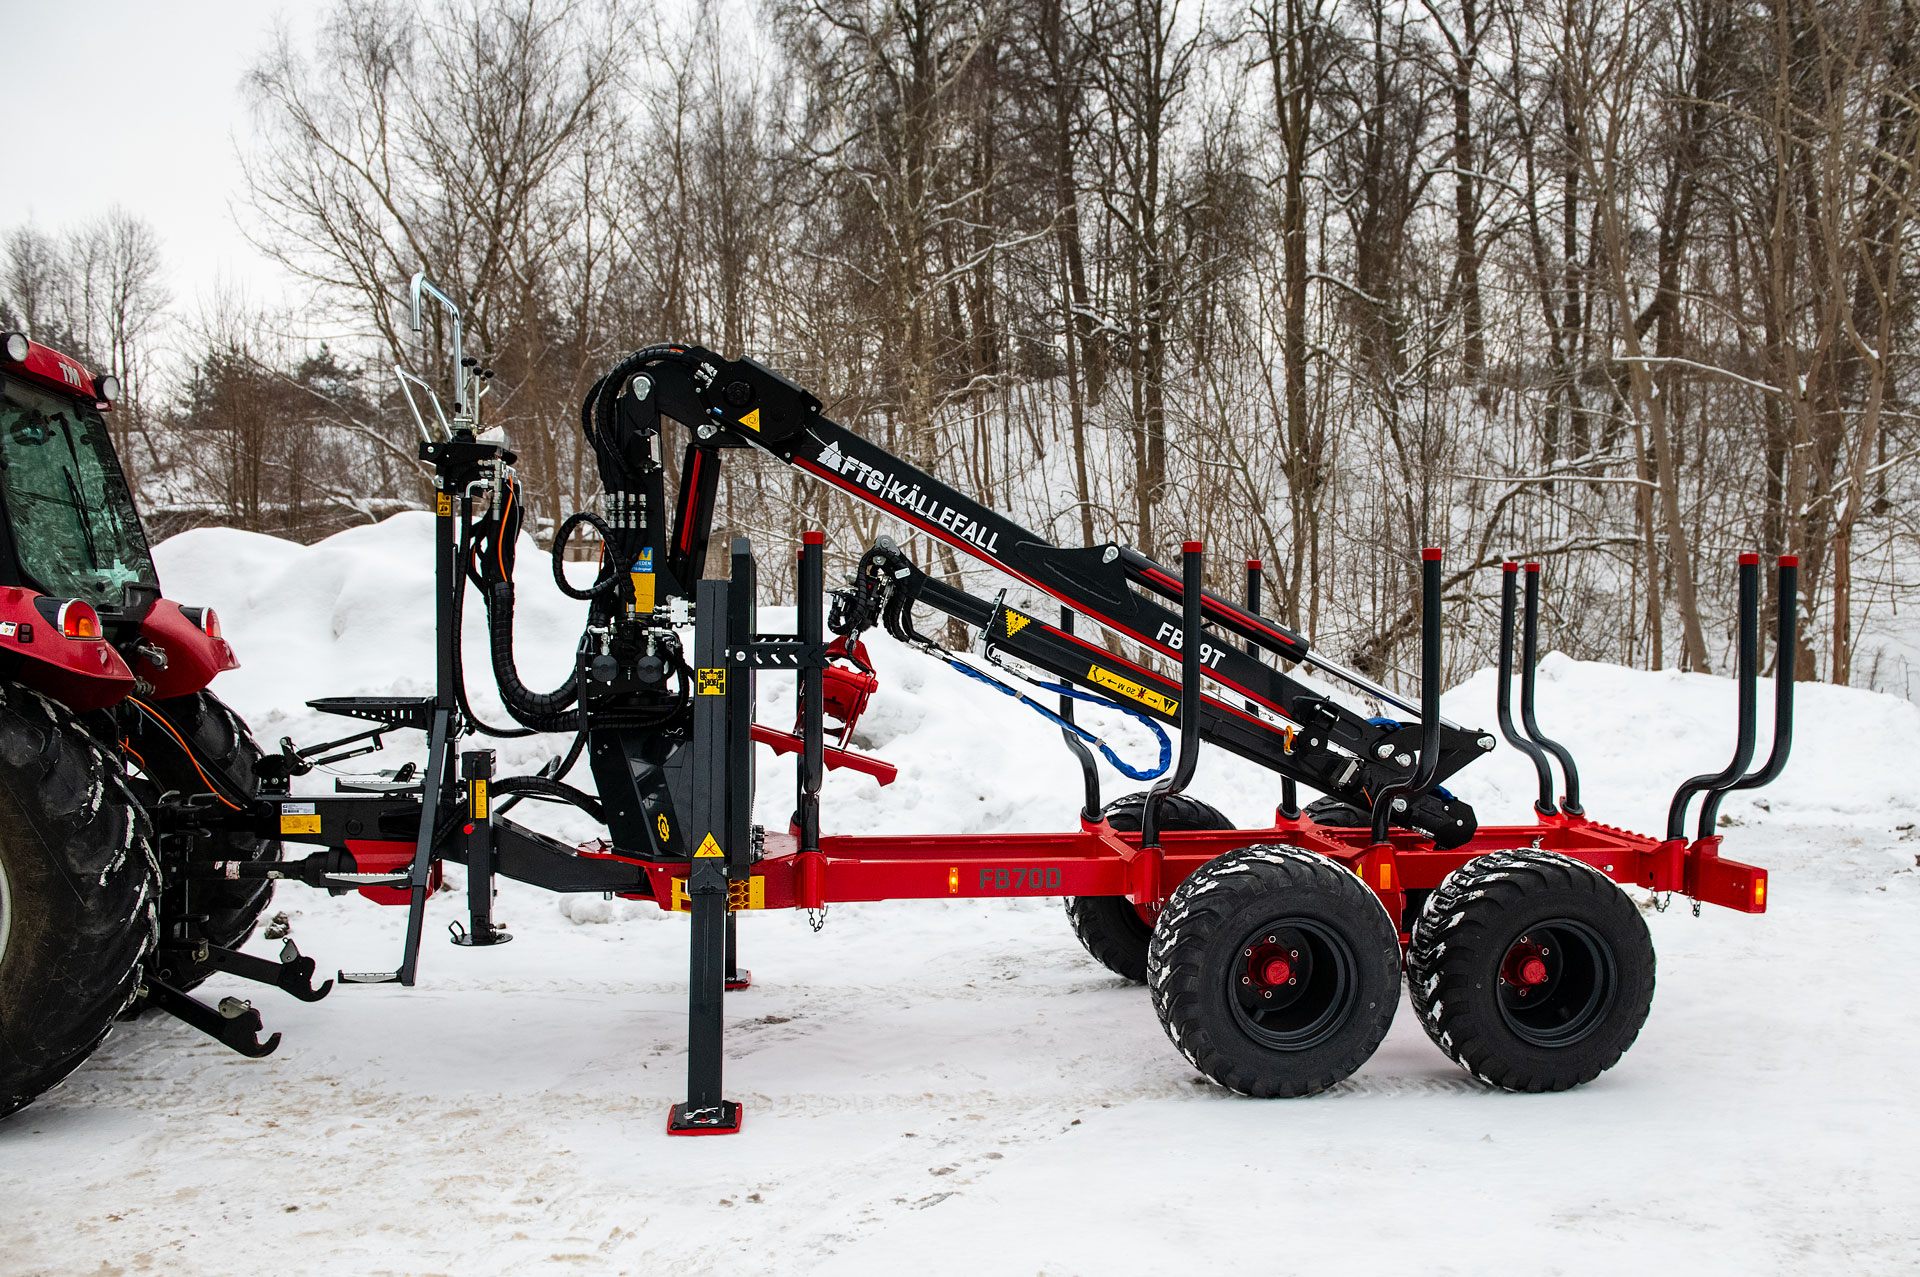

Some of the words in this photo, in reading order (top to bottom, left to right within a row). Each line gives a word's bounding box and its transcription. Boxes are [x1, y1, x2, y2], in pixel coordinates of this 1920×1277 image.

[840, 455, 885, 491] FTG
[888, 480, 999, 554] KÄLLEFALL
[1155, 621, 1227, 669] FB9T
[1117, 683, 1126, 691] M
[1126, 686, 1136, 695] 20
[979, 867, 1062, 889] FB70D
